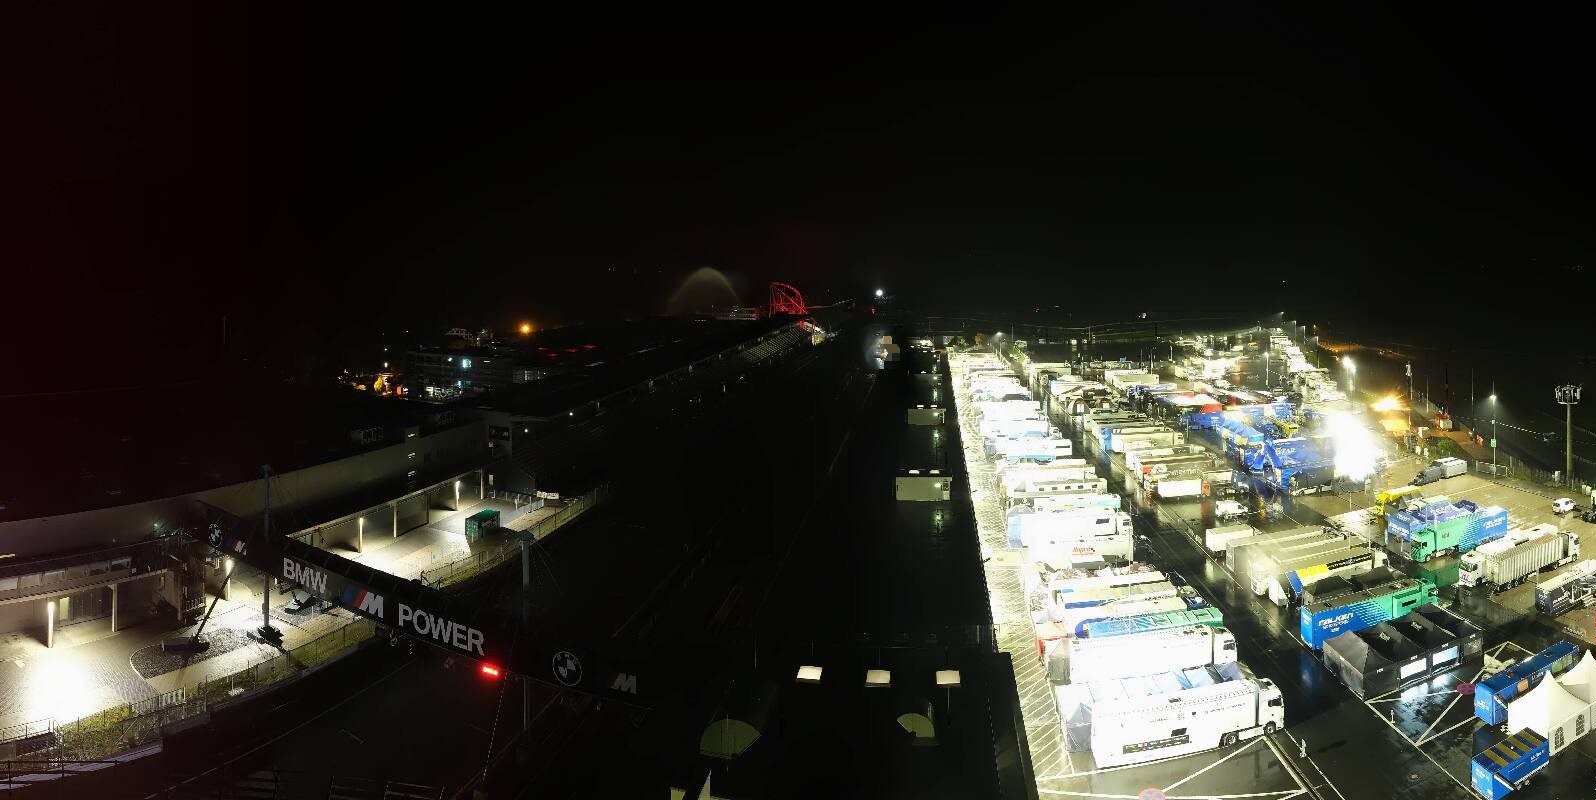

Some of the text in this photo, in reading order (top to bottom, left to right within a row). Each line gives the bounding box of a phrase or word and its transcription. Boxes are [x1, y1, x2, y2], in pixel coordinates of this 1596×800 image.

[283, 557, 328, 594] BMW
[399, 603, 485, 656] POWER
[1318, 613, 1354, 627] FALKEN
